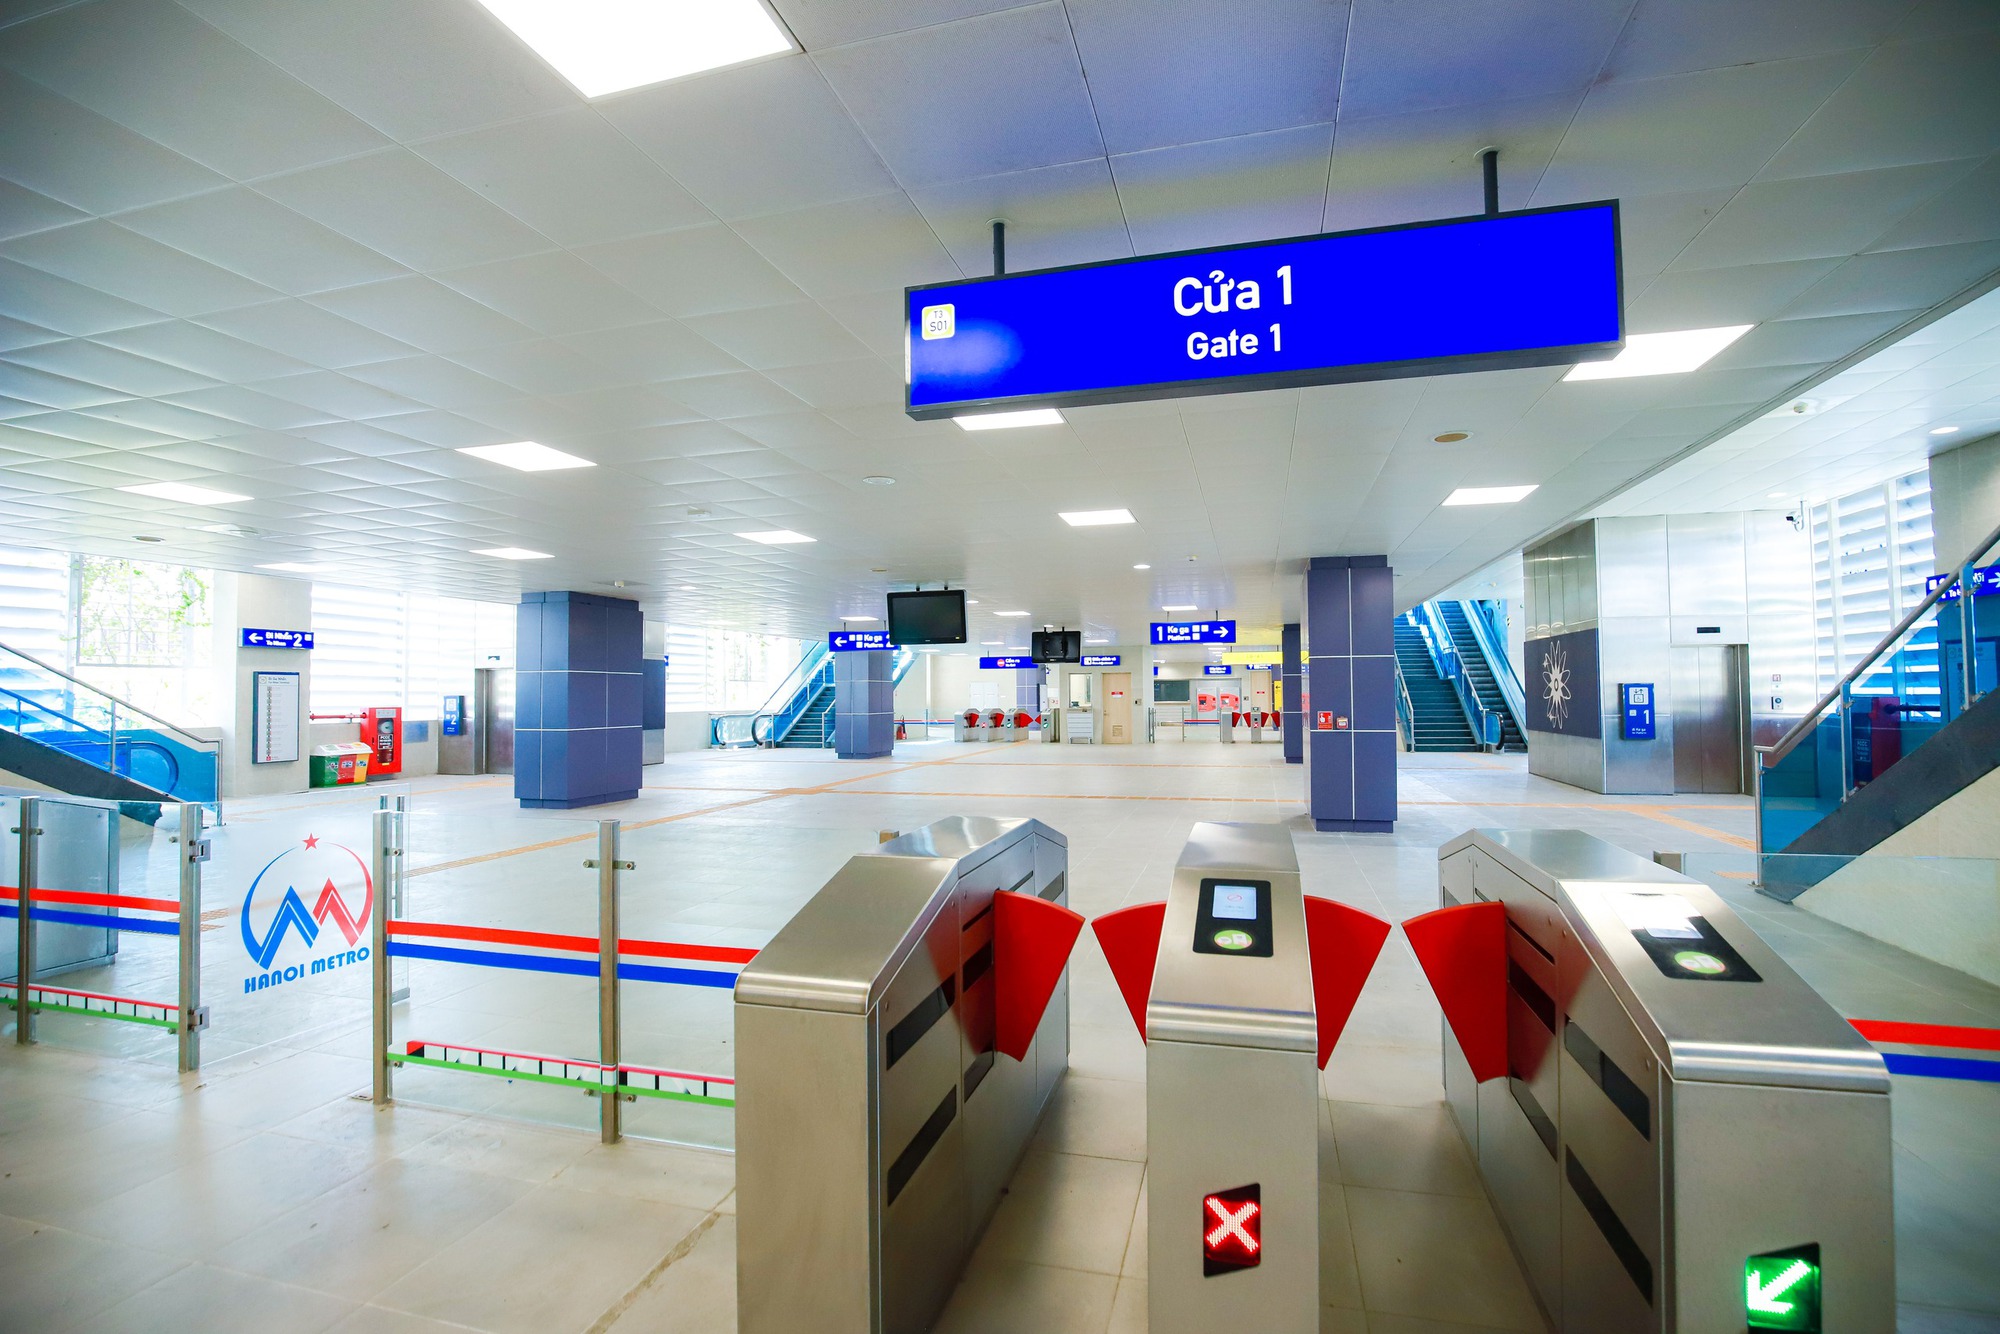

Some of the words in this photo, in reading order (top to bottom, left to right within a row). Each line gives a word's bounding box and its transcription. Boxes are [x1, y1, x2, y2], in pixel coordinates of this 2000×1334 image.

[1173, 269, 1260, 317] Cửa
[1276, 264, 1293, 305] 1
[933, 310, 943, 319] T3
[929, 320, 948, 332] S01
[1186, 328, 1259, 360] Gate
[1269, 323, 1281, 352] 1
[1156, 625, 1163, 642] 1
[1179, 626, 1190, 635] ga
[292, 633, 303, 648] 2
[450, 714, 457, 725] 2
[1643, 709, 1650, 725] 1
[244, 963, 305, 994] HANOI
[311, 946, 370, 975] METRO
